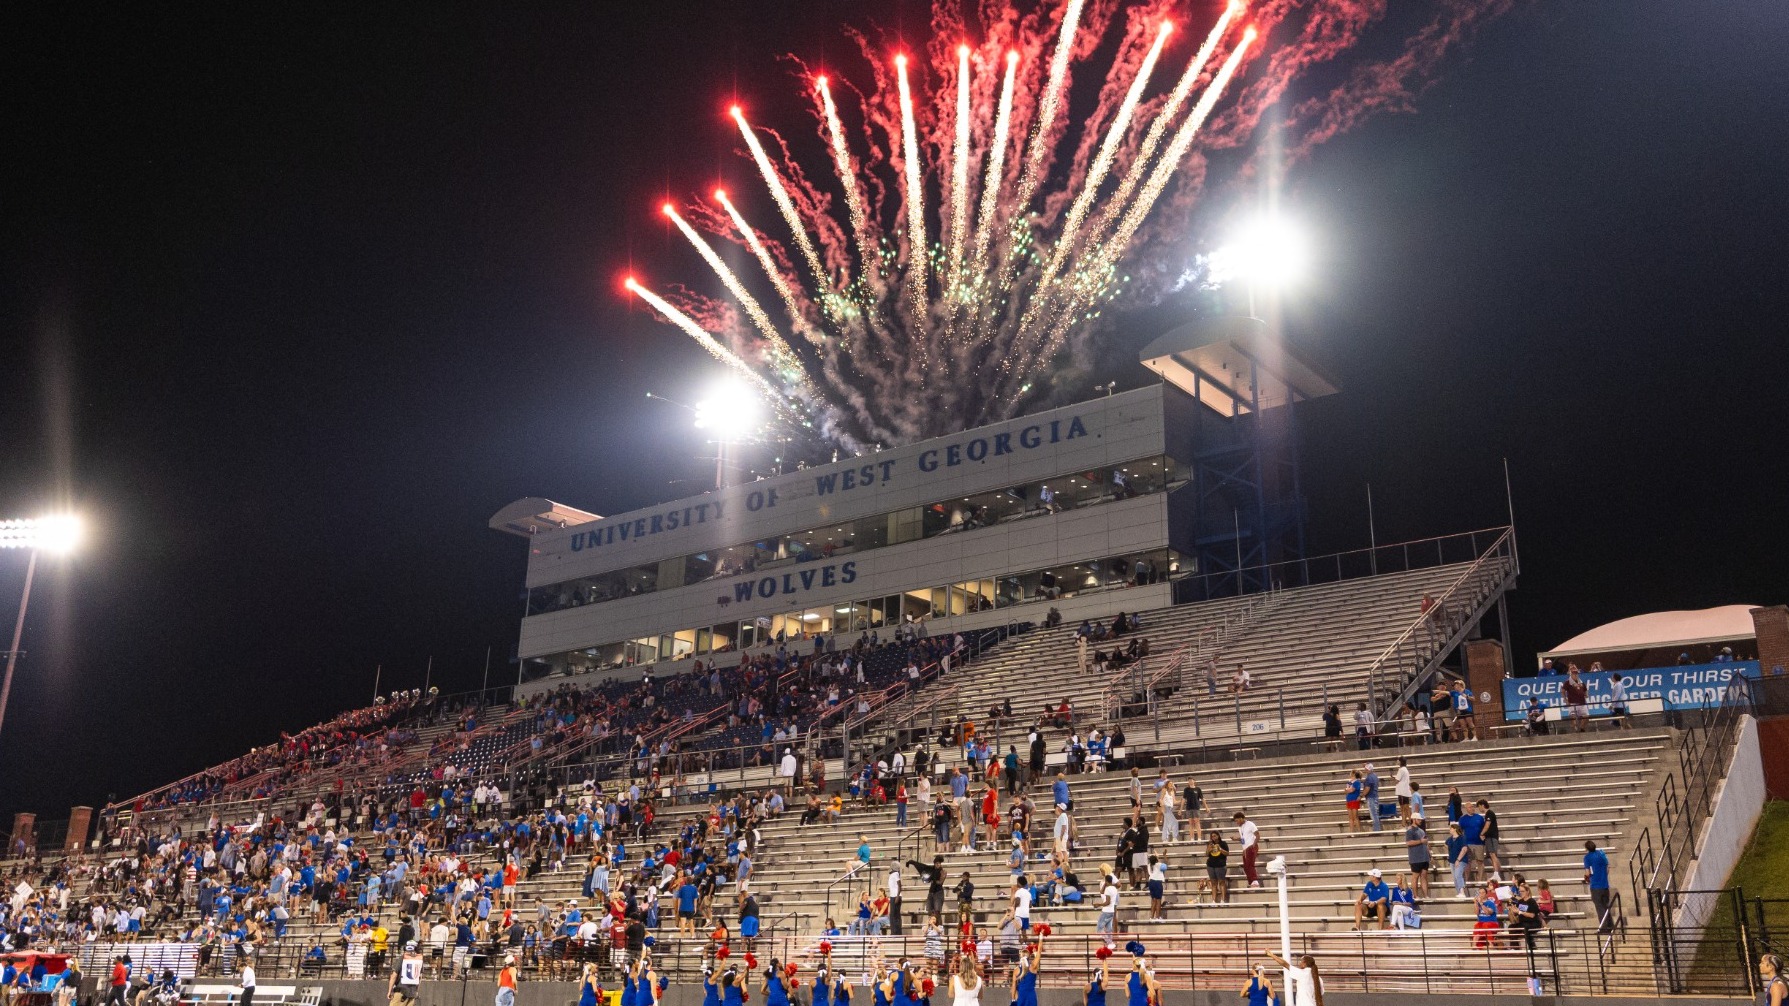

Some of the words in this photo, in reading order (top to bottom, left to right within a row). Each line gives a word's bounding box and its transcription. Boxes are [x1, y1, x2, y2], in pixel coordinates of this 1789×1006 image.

[571, 501, 725, 552] UNIVERSITY
[815, 459, 896, 496] WEST
[918, 415, 1088, 473] GEORGIA
[734, 561, 857, 602] WOLVES
[1517, 680, 1599, 696] QUEH
